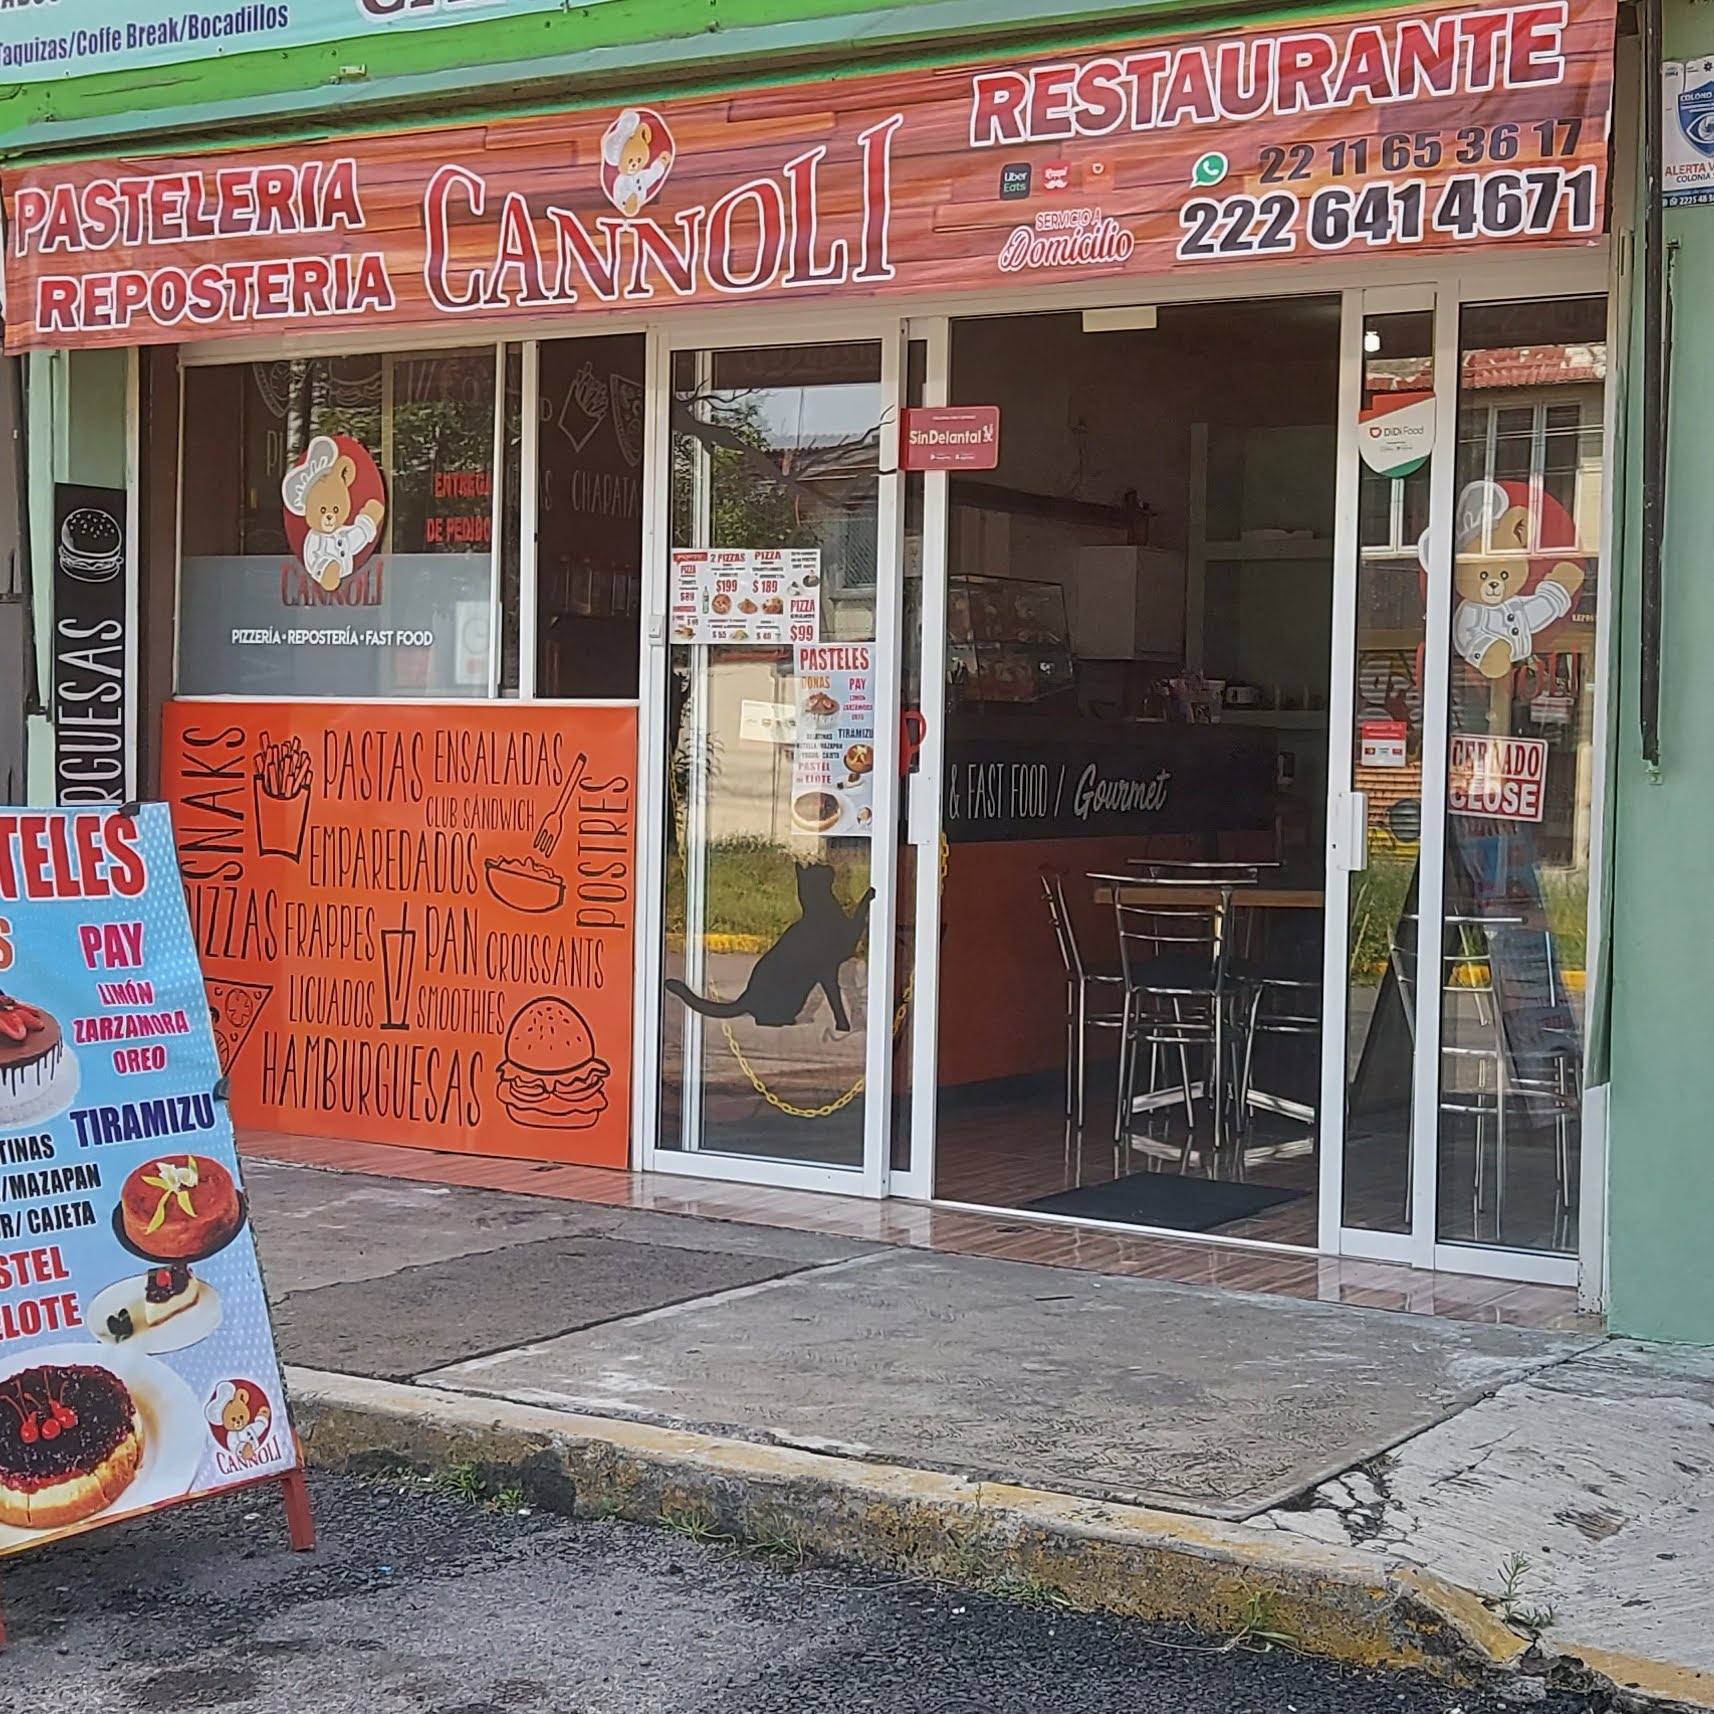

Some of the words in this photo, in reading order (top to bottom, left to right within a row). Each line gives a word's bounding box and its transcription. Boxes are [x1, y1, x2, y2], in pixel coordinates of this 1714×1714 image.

[127, 4, 288, 49] Break/Bocadillos
[970, 1, 1568, 147] RESTAURANTE
[1258, 146, 1311, 184] 22
[1328, 138, 1366, 177] 11
[1381, 130, 1442, 172] 65
[1456, 124, 1518, 164] 36
[1533, 119, 1582, 157] 17
[1665, 162, 1706, 177] ALERTA
[1003, 182, 1026, 193] Eats
[1004, 171, 1027, 182] Uber
[1676, 173, 1710, 183] COLONIA
[15, 158, 365, 258] PASTELERIA
[423, 113, 903, 313] CANNOLI
[1036, 209, 1092, 231] SERVICIO
[1091, 208, 1102, 225] A
[1177, 190, 1299, 260] 222
[1307, 178, 1424, 249] 641
[1433, 165, 1596, 240] 4671
[998, 218, 1135, 272] Domicilio
[36, 252, 395, 332] REPOSTERIA
[909, 429, 981, 445] SinDelantal
[1403, 426, 1424, 435] Food
[426, 518, 443, 543] DE
[710, 553, 716, 563] 2
[717, 552, 746, 563] PIZZAS
[754, 551, 781, 561] PIZZA
[716, 580, 738, 593] $199
[790, 599, 815, 612] PIZZA
[231, 627, 281, 645] PIZZERÍA
[288, 625, 359, 646] REPOSTERÍA
[366, 630, 393, 646] FAST
[396, 630, 433, 646] FOOD
[790, 625, 813, 641] $99
[800, 647, 869, 671] PASTELES
[849, 678, 866, 690] PAY
[323, 729, 424, 803] PASTAS
[433, 729, 564, 788] ENSALADAS
[799, 762, 831, 771] PASTEL
[1453, 740, 1539, 777] CERADO
[180, 726, 246, 882] SNAKS
[967, 763, 1005, 819] FAST
[1010, 763, 1049, 818] FOOD
[1073, 763, 1171, 820] Gourmet
[1449, 782, 1538, 815] CLOSE
[425, 796, 458, 829] CLUB
[308, 825, 479, 896] EMPAREDADOS
[575, 775, 630, 931] POSTRES
[79, 922, 143, 970] PAY
[284, 900, 376, 963] FRAPPES
[424, 904, 479, 977] PAN
[486, 930, 604, 989] CROISSANTS
[97, 979, 154, 1006] LIMÓN
[289, 973, 376, 1029] LICUADOS
[416, 984, 506, 1037] SMOOTHIES
[73, 1010, 190, 1044] ZARZAMORA
[113, 1045, 167, 1075] OREO
[262, 1031, 484, 1129] HAMBURGUESAS
[70, 1092, 216, 1148] TIRAMIZU
[27, 1200, 97, 1236] CAJETA
